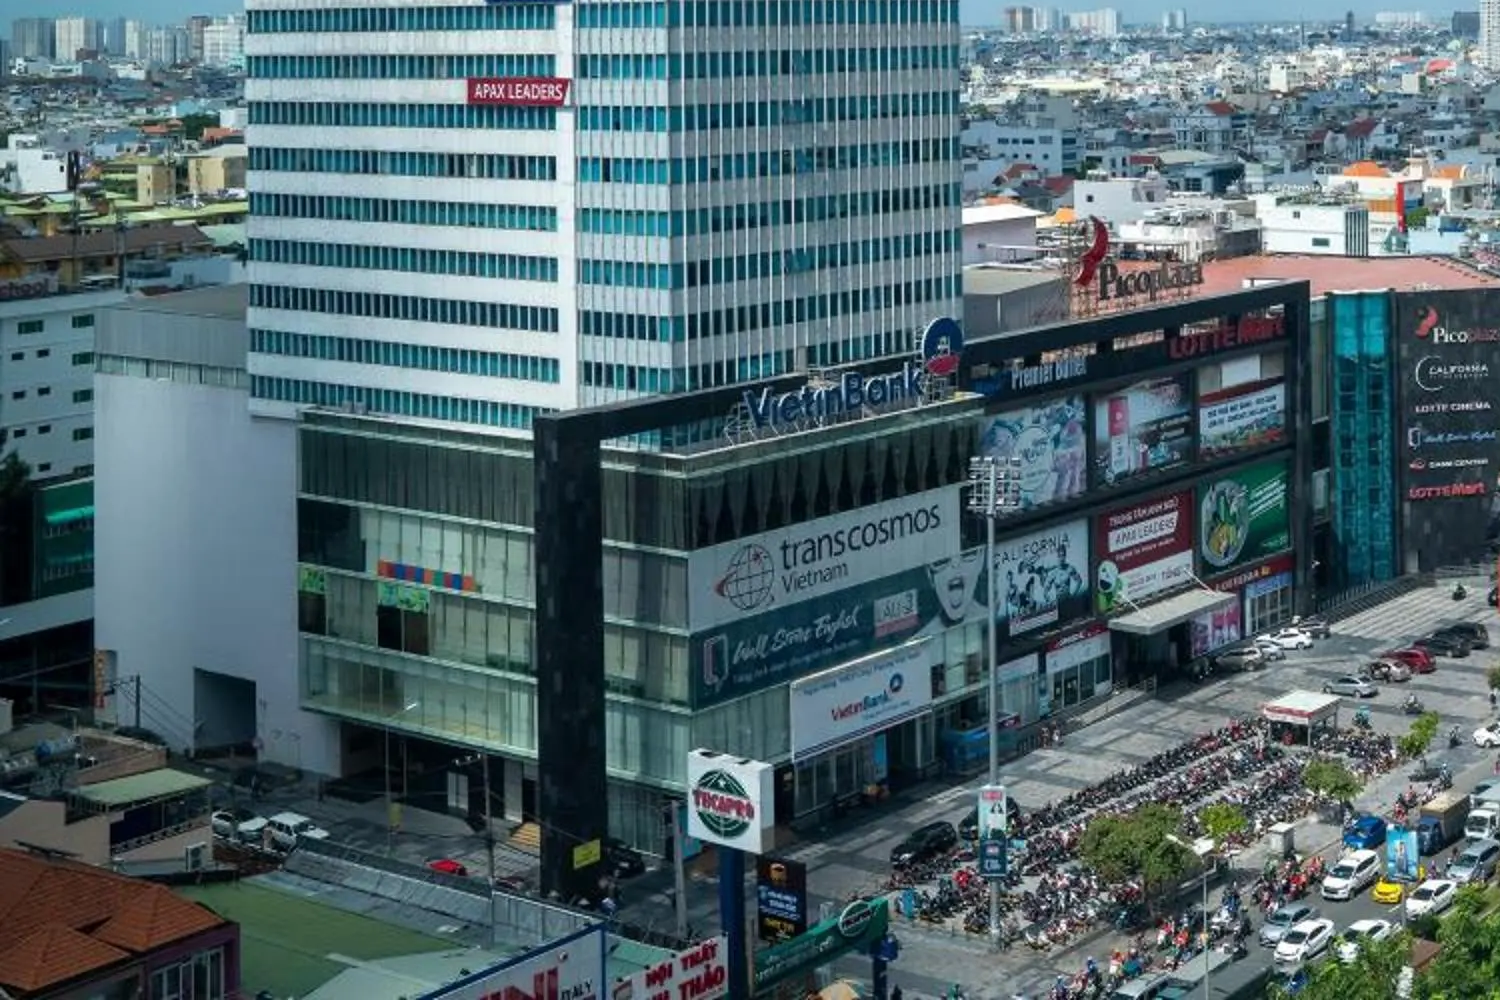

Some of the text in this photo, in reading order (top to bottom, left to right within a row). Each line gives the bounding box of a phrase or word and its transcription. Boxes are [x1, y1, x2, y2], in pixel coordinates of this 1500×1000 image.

[474, 83, 563, 100] APAX LEADERS
[1012, 362, 1053, 390] Premier
[744, 361, 925, 429] VietinBank
[1415, 401, 1491, 413] LOTTE CINEMA
[780, 503, 941, 570] transcosmos
[1139, 517, 1174, 539] LEADERS
[781, 561, 849, 594] Vietnam
[831, 689, 889, 721] VietinBank
